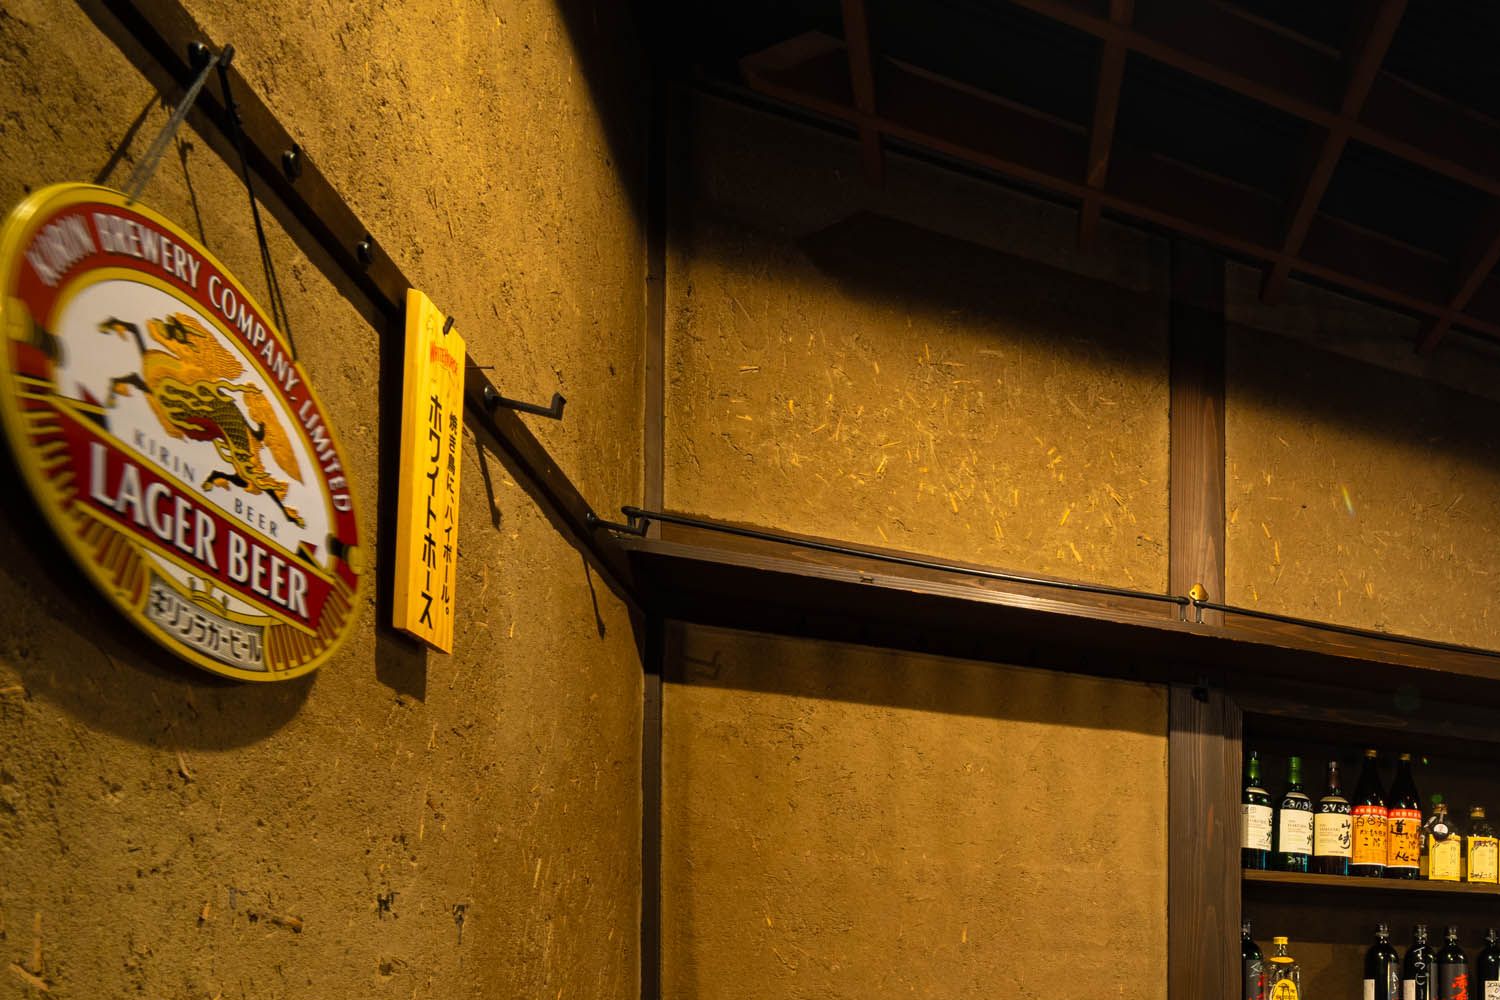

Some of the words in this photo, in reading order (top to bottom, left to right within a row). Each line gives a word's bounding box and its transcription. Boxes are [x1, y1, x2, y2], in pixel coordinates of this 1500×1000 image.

[92, 212, 200, 288] BREWERY
[299, 399, 351, 512] LIMITED
[133, 428, 195, 483] KIRIN
[234, 497, 279, 537] BEER
[419, 394, 443, 629] ホワイトホース
[89, 441, 219, 571] LAGER
[228, 530, 309, 619] BEER
[151, 587, 262, 665] キリンラガービール
